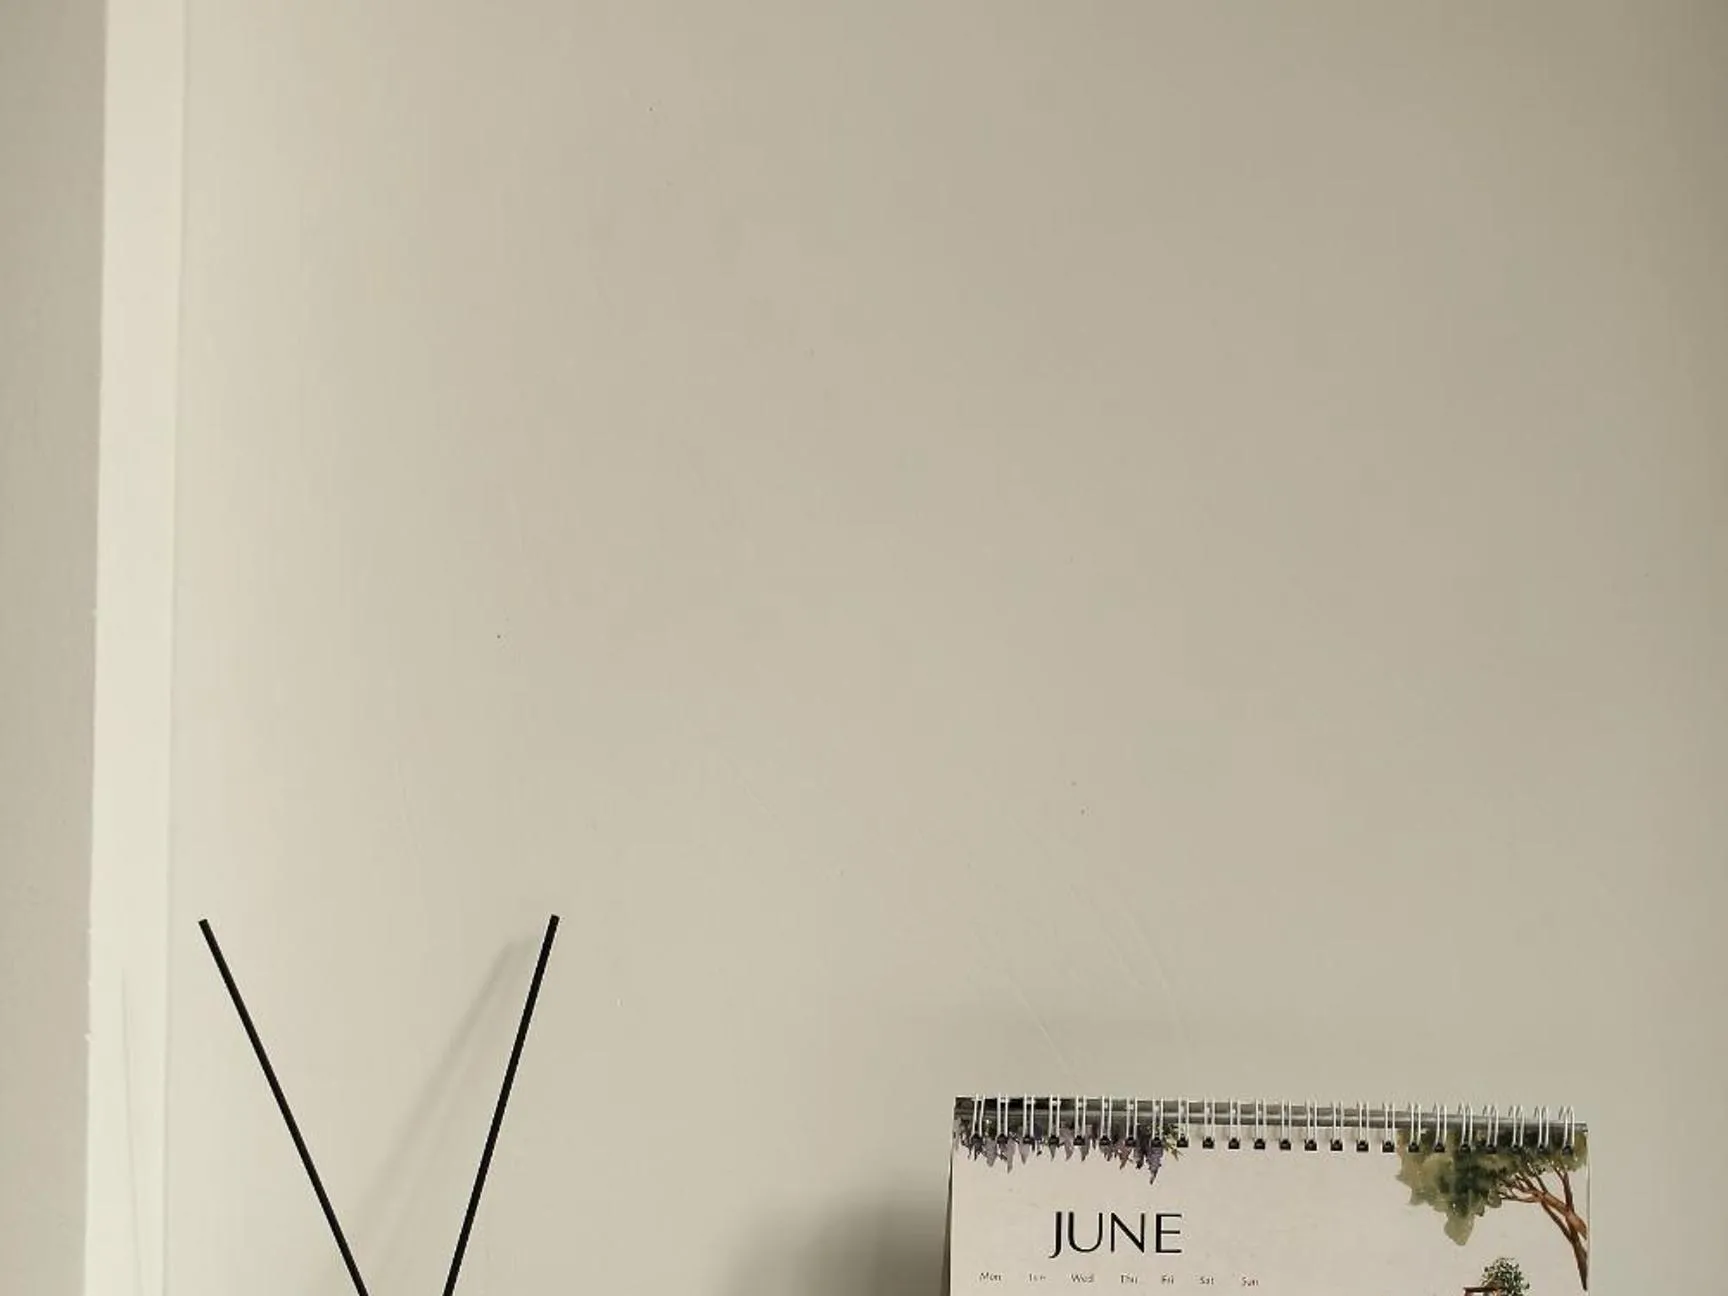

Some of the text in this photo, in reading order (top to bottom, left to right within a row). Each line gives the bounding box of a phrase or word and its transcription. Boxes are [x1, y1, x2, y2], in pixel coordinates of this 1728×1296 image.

[1047, 1210, 1183, 1259] JUNE
[979, 1271, 1002, 1282] Mon
[1070, 1273, 1095, 1284] Wed
[1161, 1274, 1175, 1285] Fri
[1199, 1275, 1215, 1286] Sat
[1240, 1276, 1259, 1288] Sun
